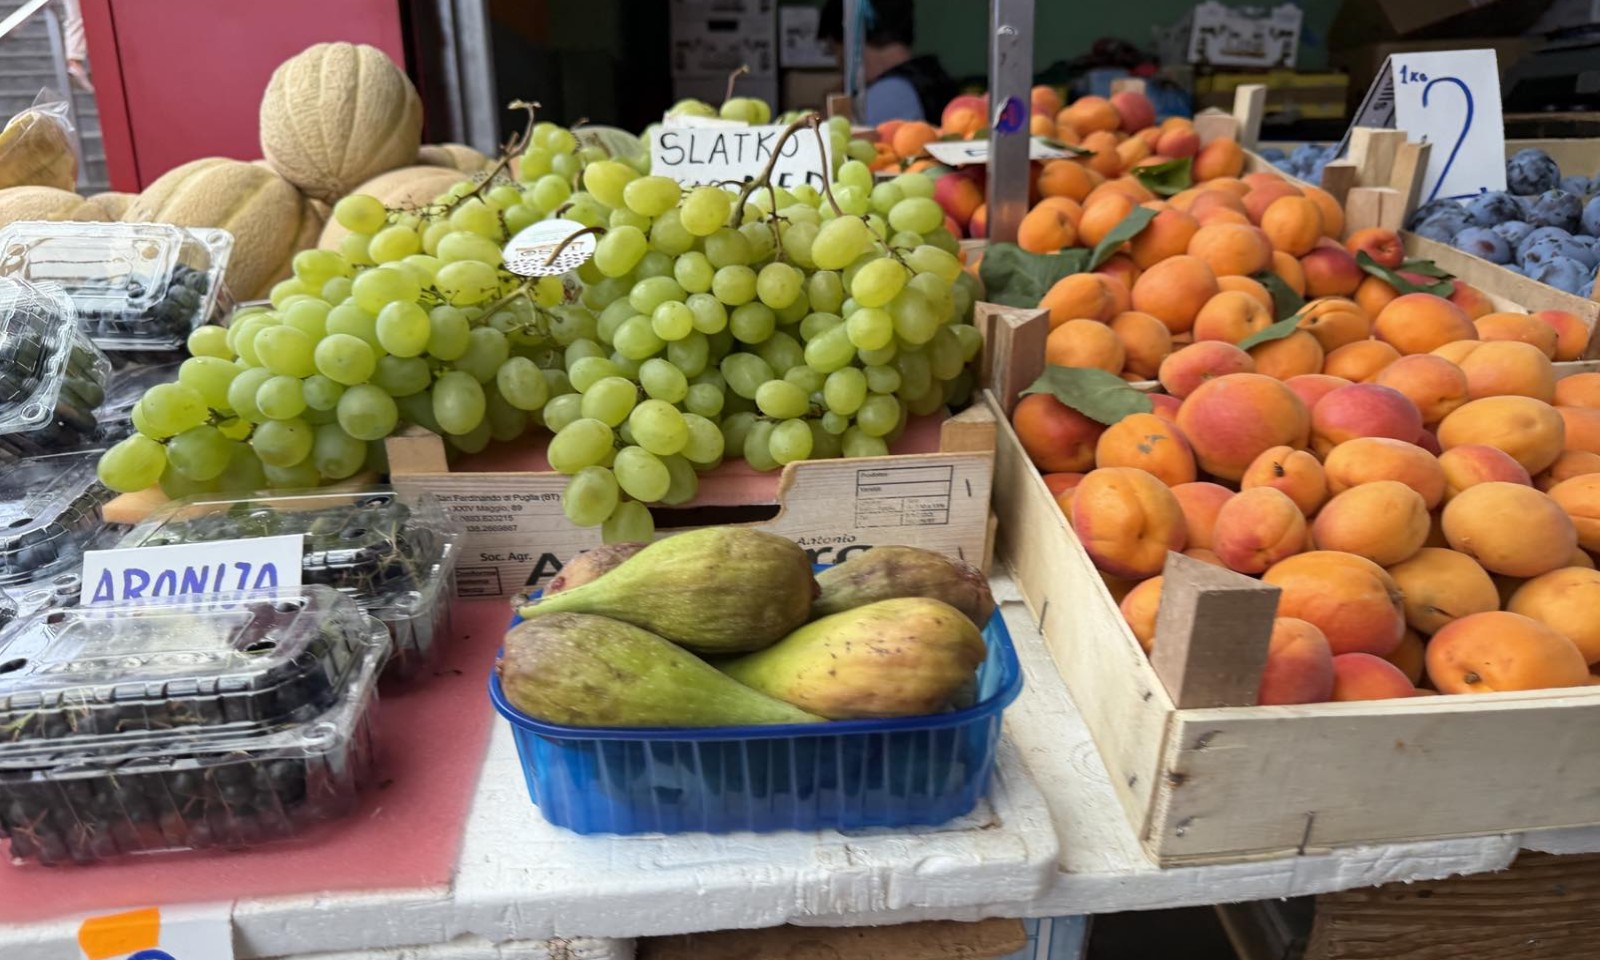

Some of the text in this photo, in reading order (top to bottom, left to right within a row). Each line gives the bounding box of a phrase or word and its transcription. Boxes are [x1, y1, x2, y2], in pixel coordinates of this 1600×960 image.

[1422, 77, 1488, 202] 2
[660, 131, 799, 166] SLATKO
[513, 494, 540, 502] Puglia
[541, 493, 560, 502] (BT)
[797, 534, 856, 545] Antonio
[480, 552, 505, 561] Soc.
[508, 552, 533, 562] Agr.
